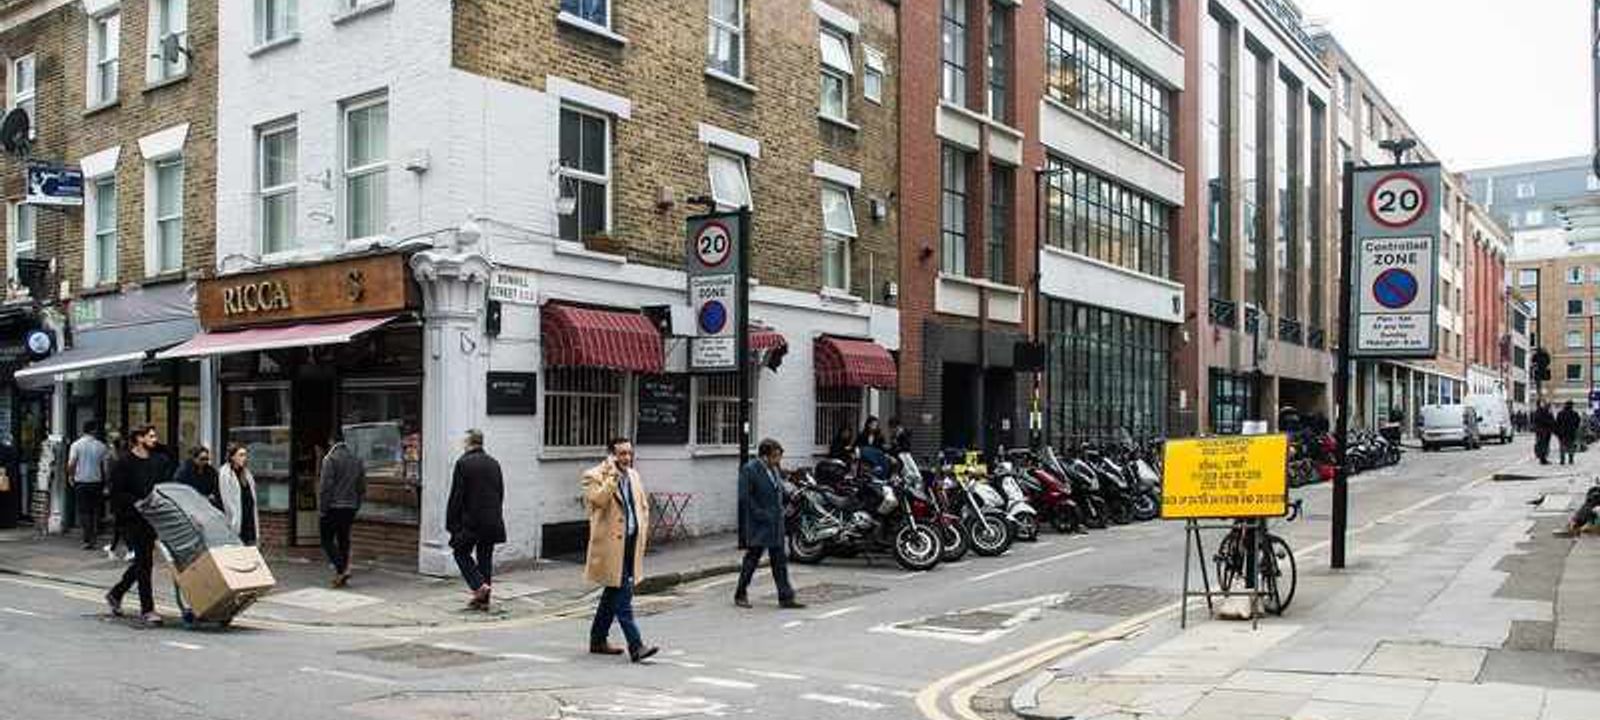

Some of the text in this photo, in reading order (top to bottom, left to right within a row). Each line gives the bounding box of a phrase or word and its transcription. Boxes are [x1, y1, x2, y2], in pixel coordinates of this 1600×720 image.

[1378, 190, 1419, 211] 20
[701, 234, 725, 254] 20
[1366, 241, 1427, 252] Controlled
[1374, 252, 1417, 265] ZONE
[223, 281, 290, 315] RICCA
[490, 286, 517, 299] STREET
